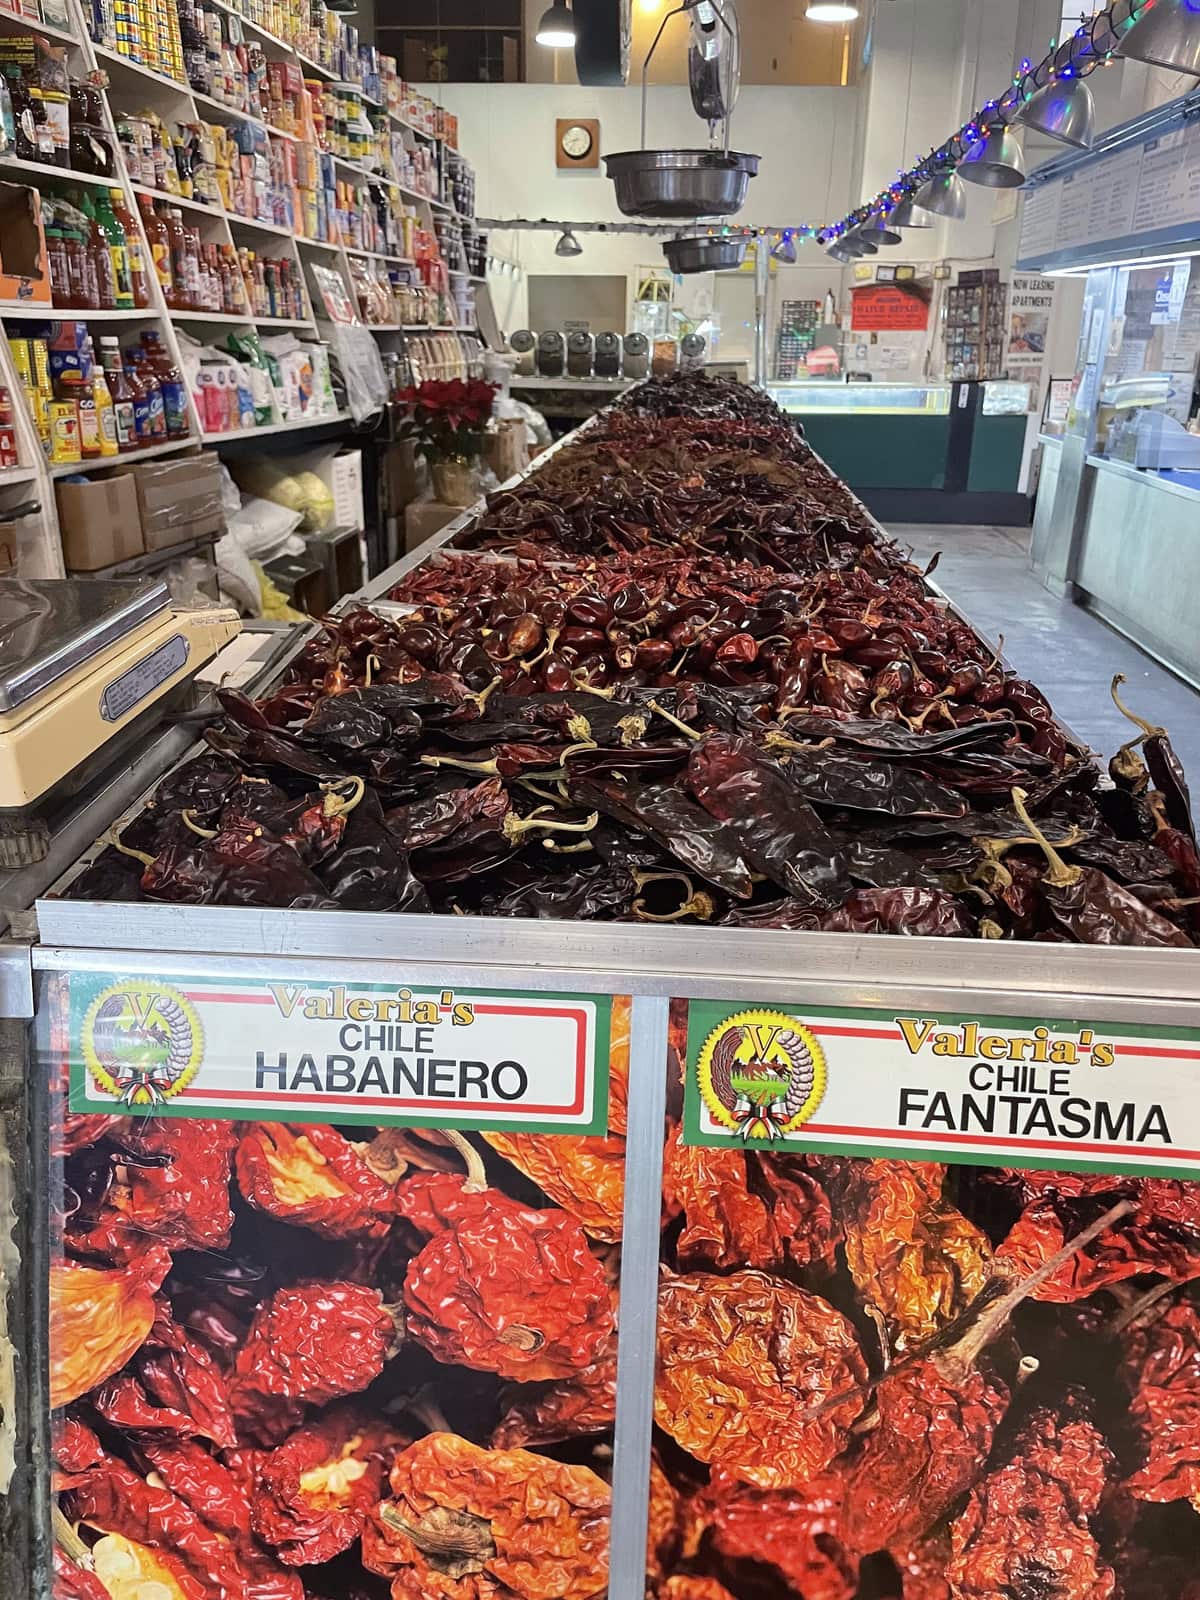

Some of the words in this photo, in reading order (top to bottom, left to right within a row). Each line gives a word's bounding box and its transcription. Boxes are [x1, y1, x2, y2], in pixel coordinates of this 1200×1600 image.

[1012, 295, 1052, 307] APARTMENTS
[1013, 279, 1028, 290] NOW
[1029, 279, 1055, 291] LEASING
[267, 983, 475, 1027] Valeria's
[338, 1023, 434, 1053] CHILE
[742, 1023, 783, 1061] V
[894, 1017, 1116, 1068] Valeria's
[255, 1051, 529, 1101] HABANERO
[969, 1062, 1070, 1096] CHILE
[898, 1088, 1173, 1144] FANTASMA
